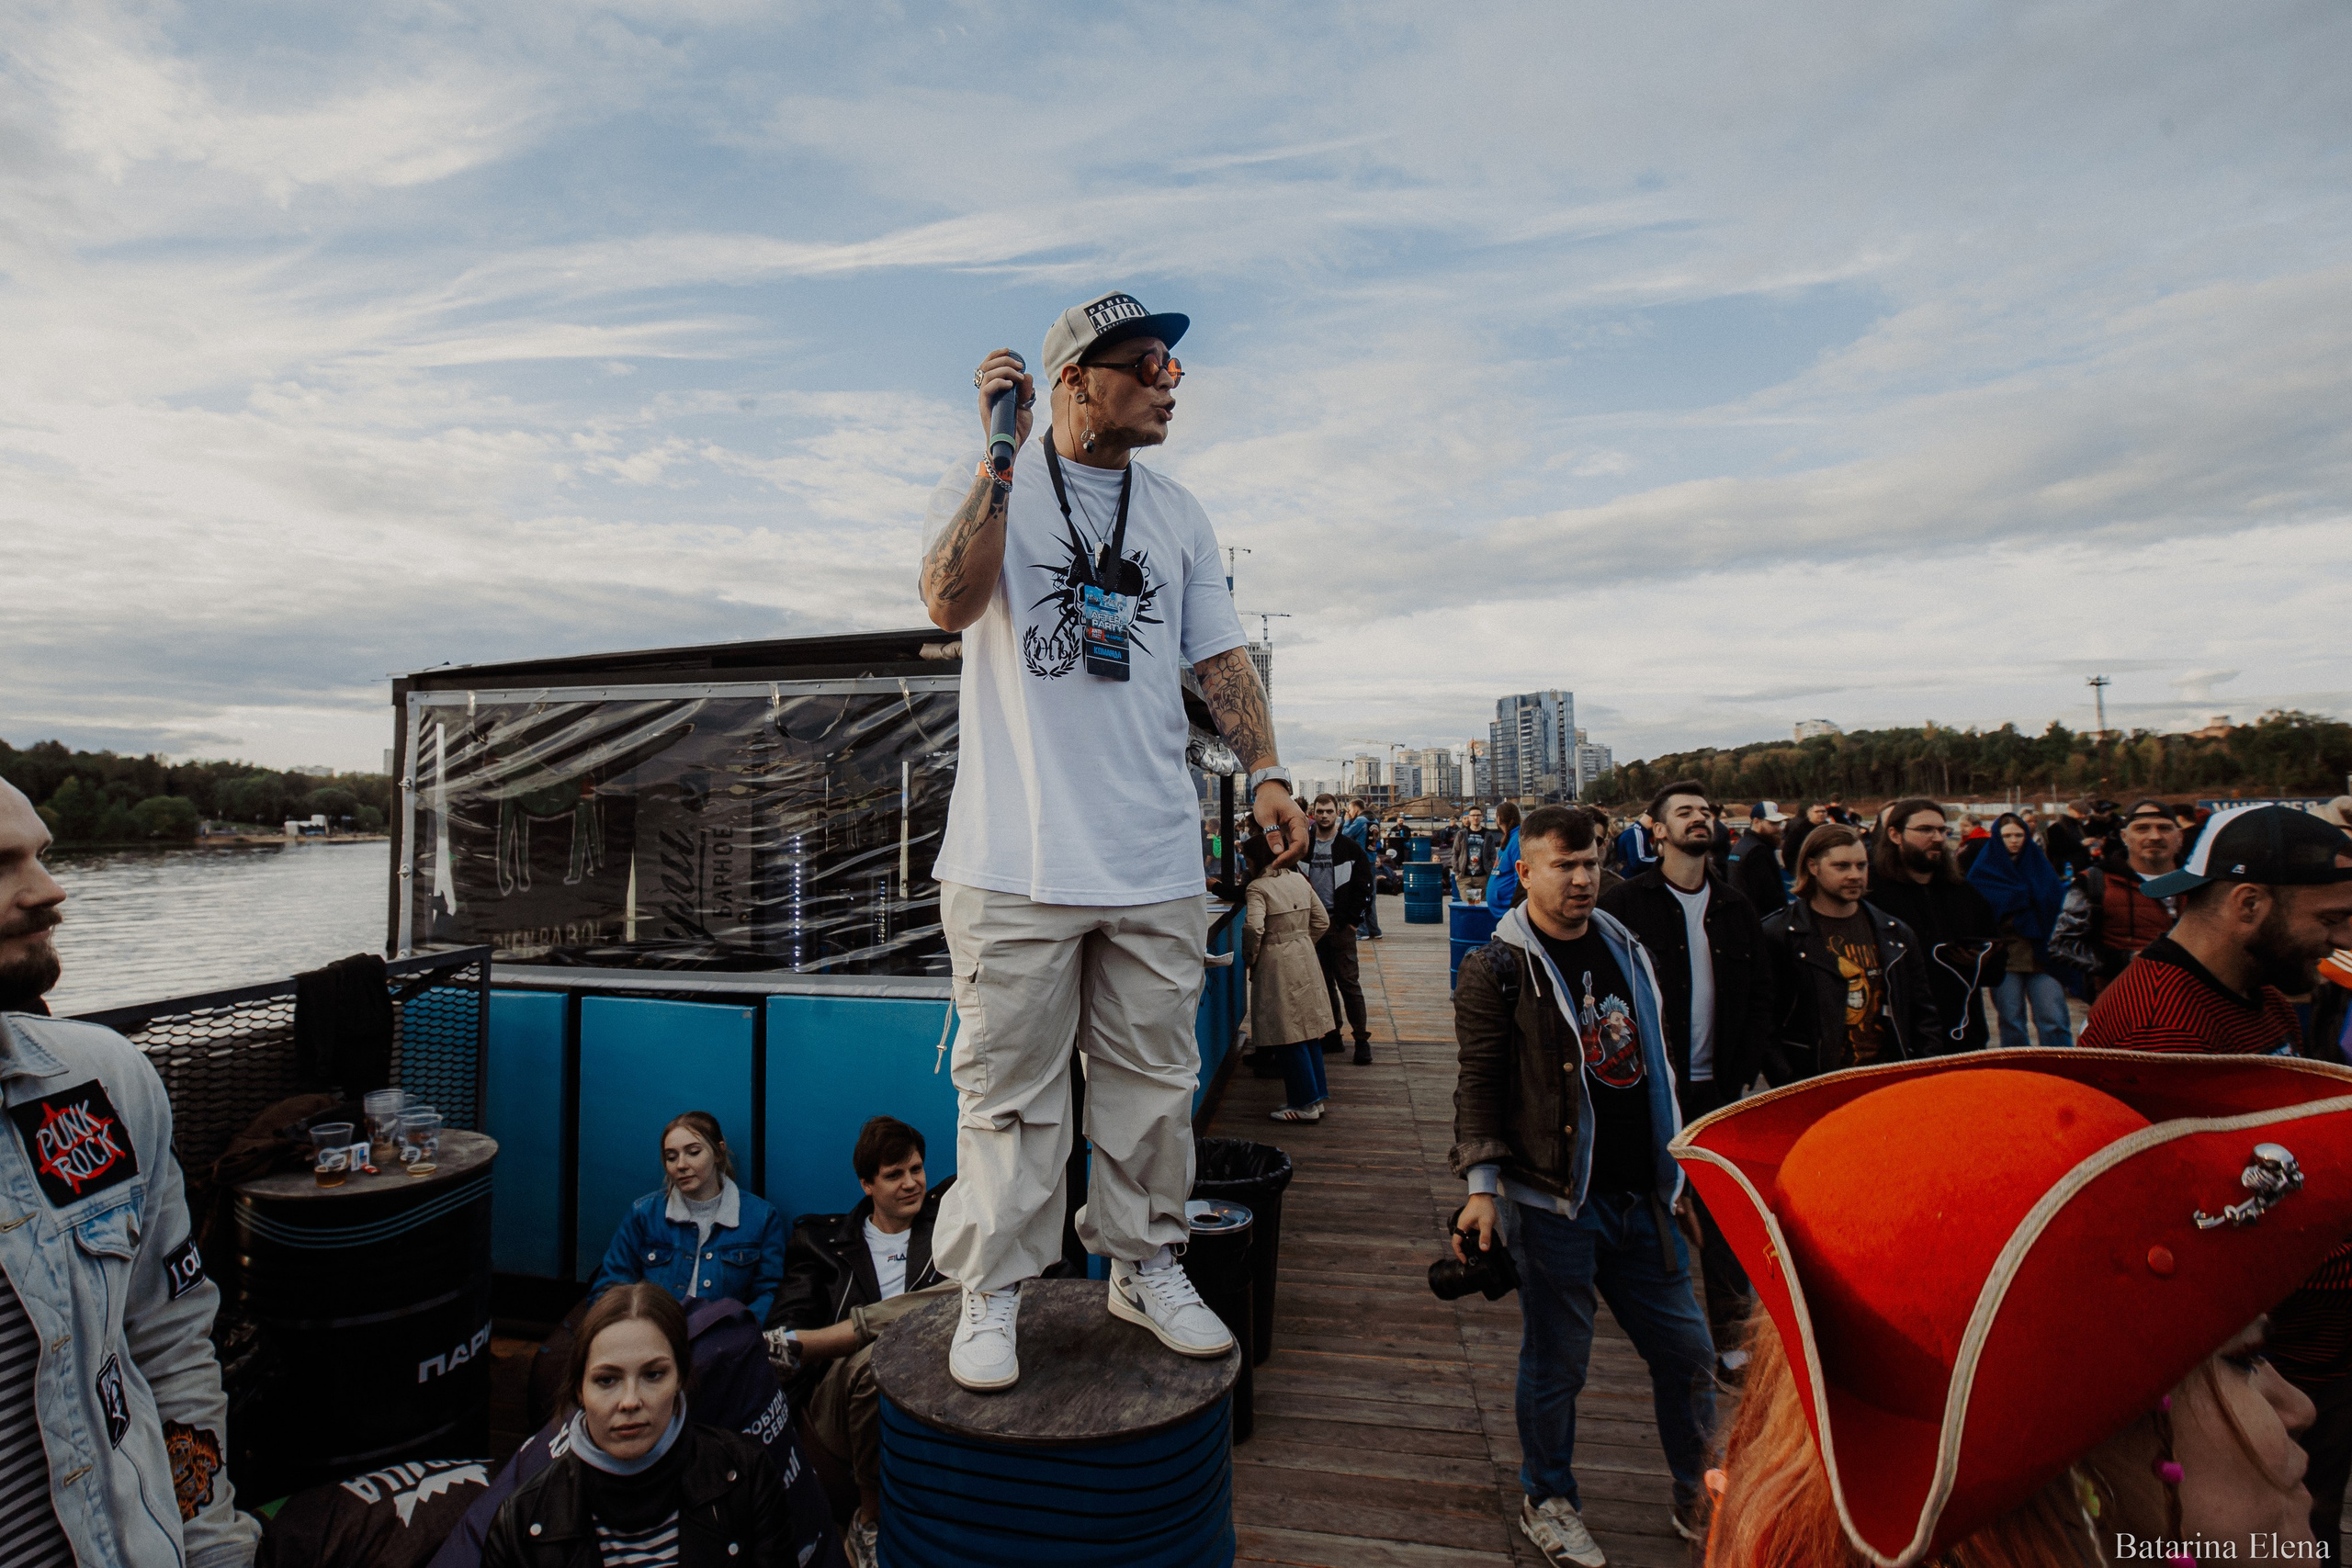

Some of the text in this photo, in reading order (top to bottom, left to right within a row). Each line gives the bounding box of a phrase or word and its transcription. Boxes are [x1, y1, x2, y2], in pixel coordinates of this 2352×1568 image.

[1089, 297, 1129, 315] PAREN
[1091, 304, 1144, 329] ADVISO
[1091, 619, 1123, 634] PARTY
[1093, 645, 1123, 660] КОМАНДА
[712, 827, 734, 918] БАРНОЕ
[36, 1099, 102, 1161] PUNK
[51, 1123, 121, 1187] ROCK
[887, 1252, 907, 1262] FILA
